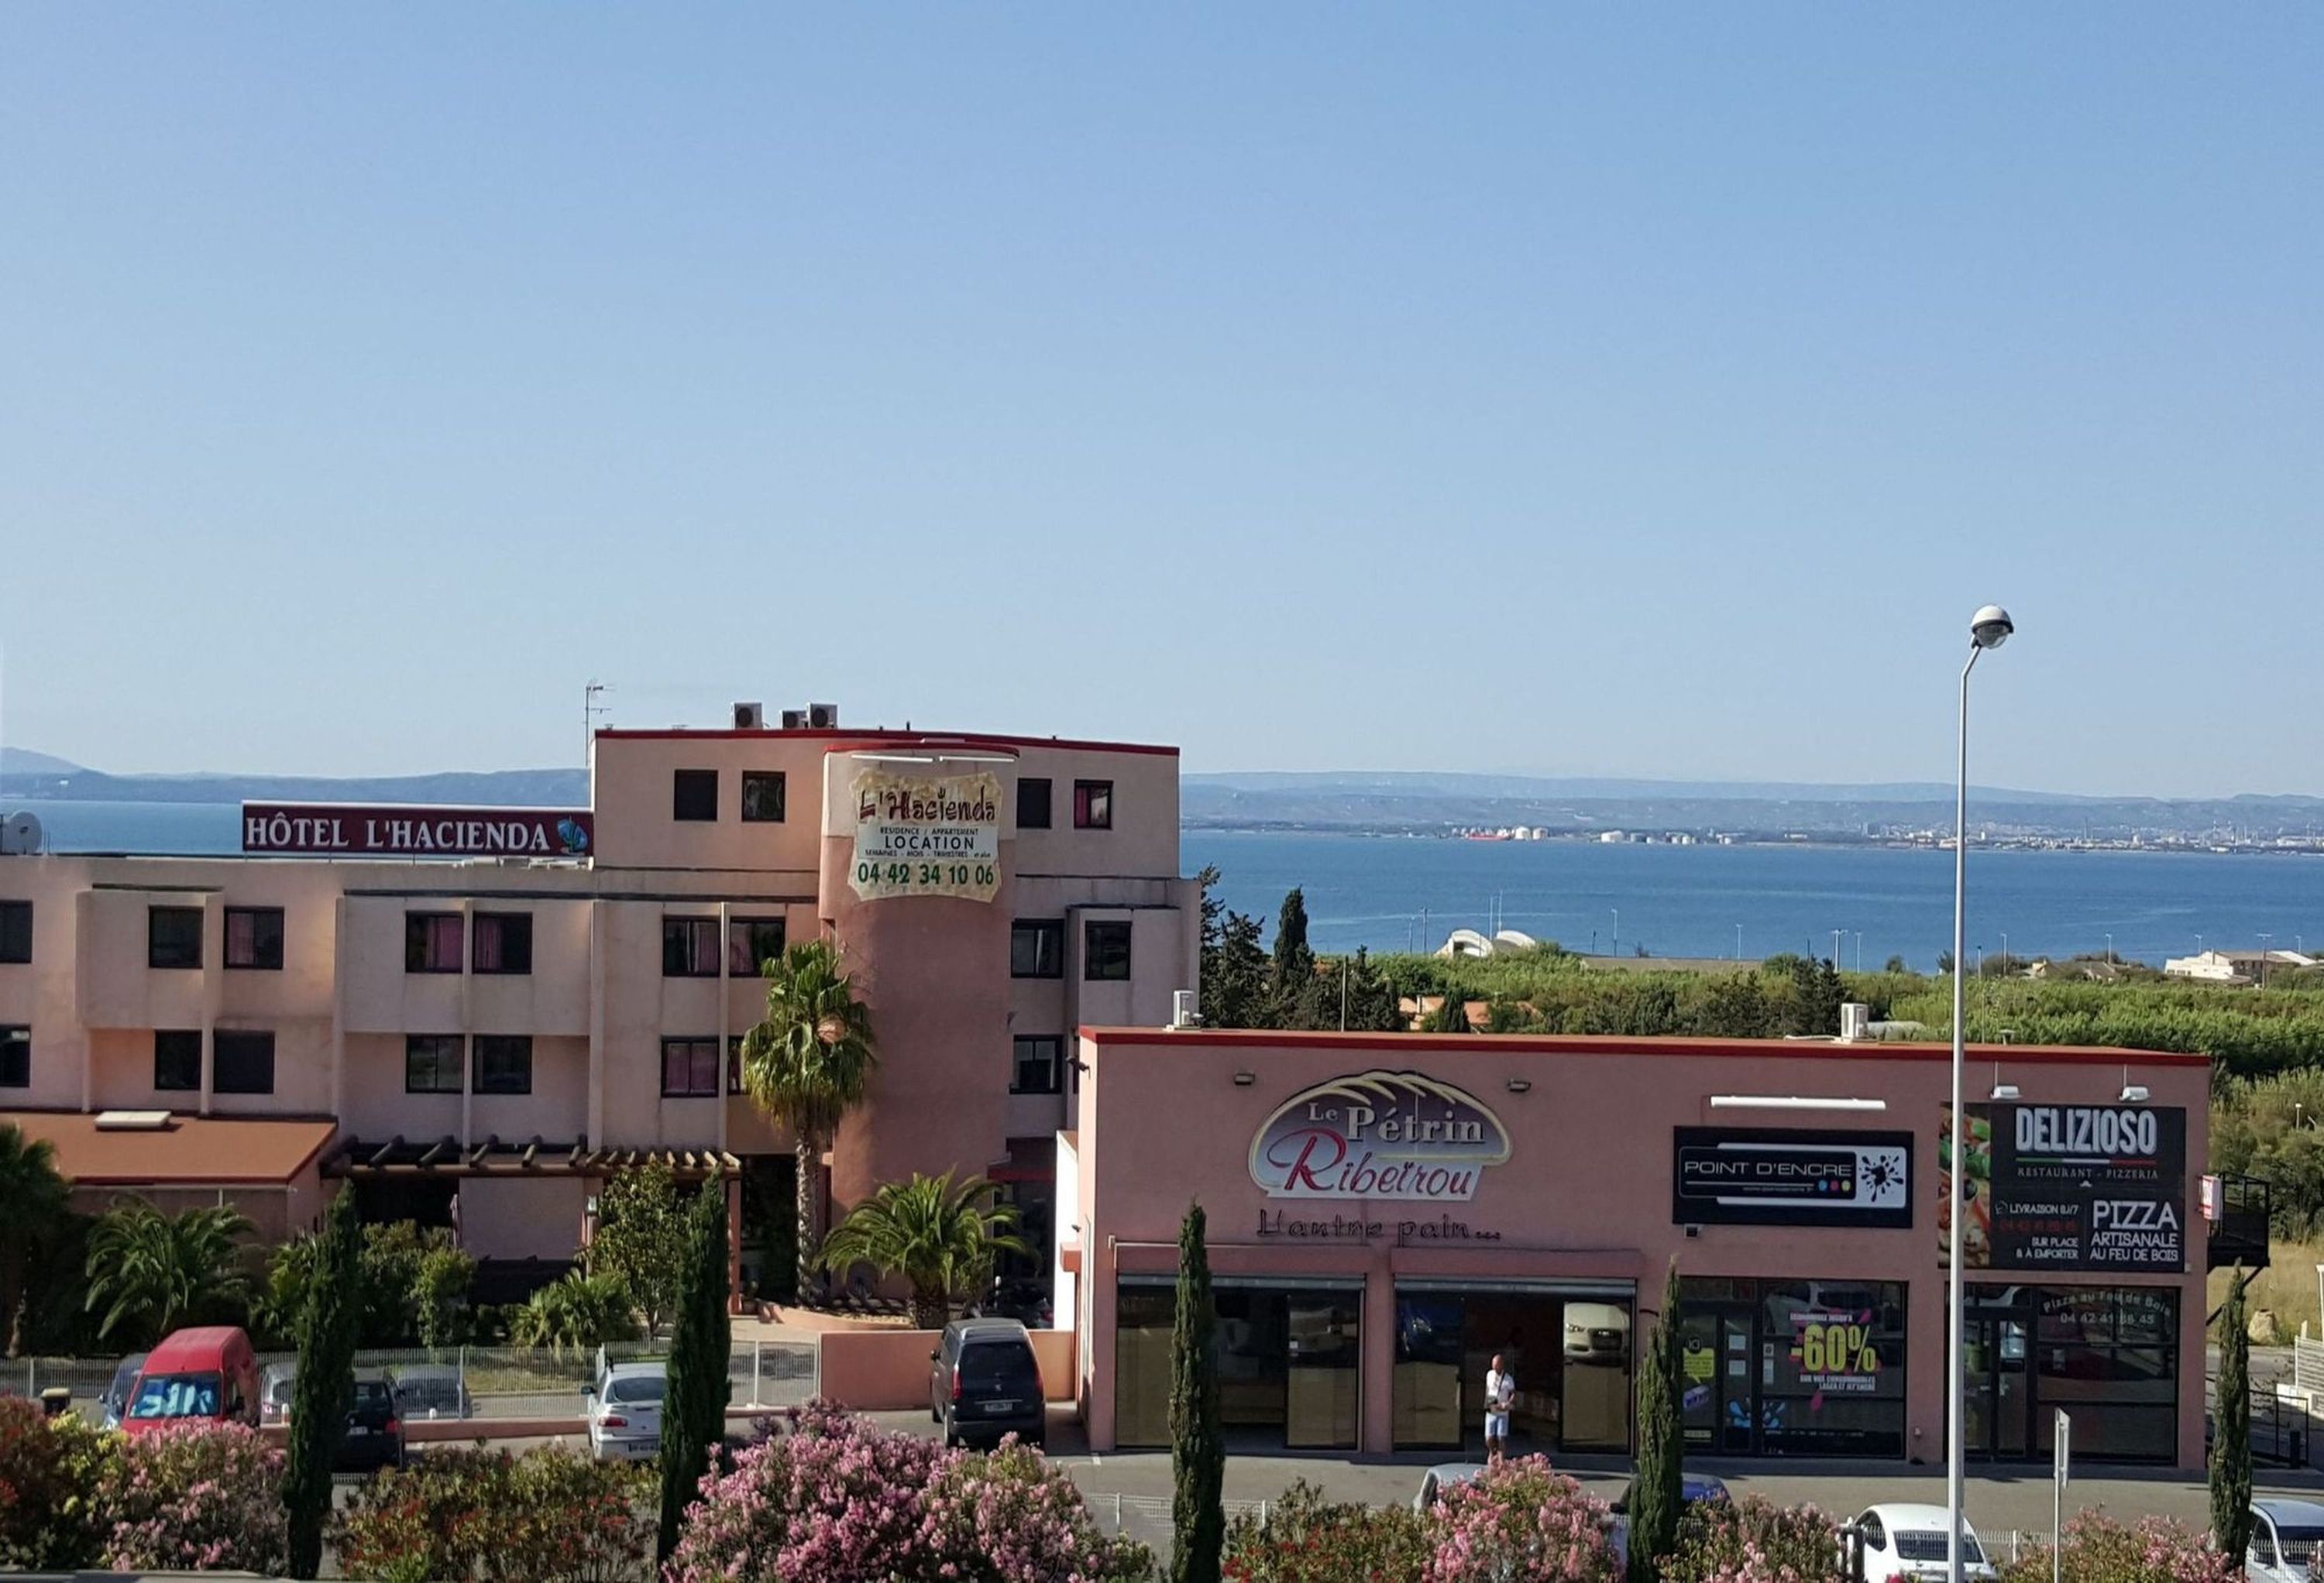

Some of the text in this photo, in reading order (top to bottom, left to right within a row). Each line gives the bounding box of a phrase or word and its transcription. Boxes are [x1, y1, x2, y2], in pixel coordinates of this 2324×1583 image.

[860, 785, 995, 822] L'Hacienda
[246, 812, 549, 850] HÔTEL L'HACIENDA
[885, 836, 974, 850] LOCATION
[858, 863, 994, 884] 04 42 34 10 06
[1308, 1102, 1486, 1144] Le Pétrin
[2016, 1107, 2157, 1155] DELIZIOSO
[1685, 1162, 1852, 1176] POINT D'ENCRE
[2018, 1167, 2092, 1178] RESTAURANT
[2106, 1169, 2157, 1179] PIZZERIA
[2009, 1204, 2058, 1214] LIVRAISON
[2093, 1200, 2178, 1230] PIZZA
[2032, 1237, 2078, 1247] SUR PLACE
[2091, 1231, 2178, 1247] ARTISANALE
[2034, 1248, 2078, 1259] EMPORTER
[2090, 1248, 2178, 1262] AU FEU DE BOIS
[2044, 1294, 2077, 1313] Pizza
[1791, 1324, 1875, 1372] -60%
